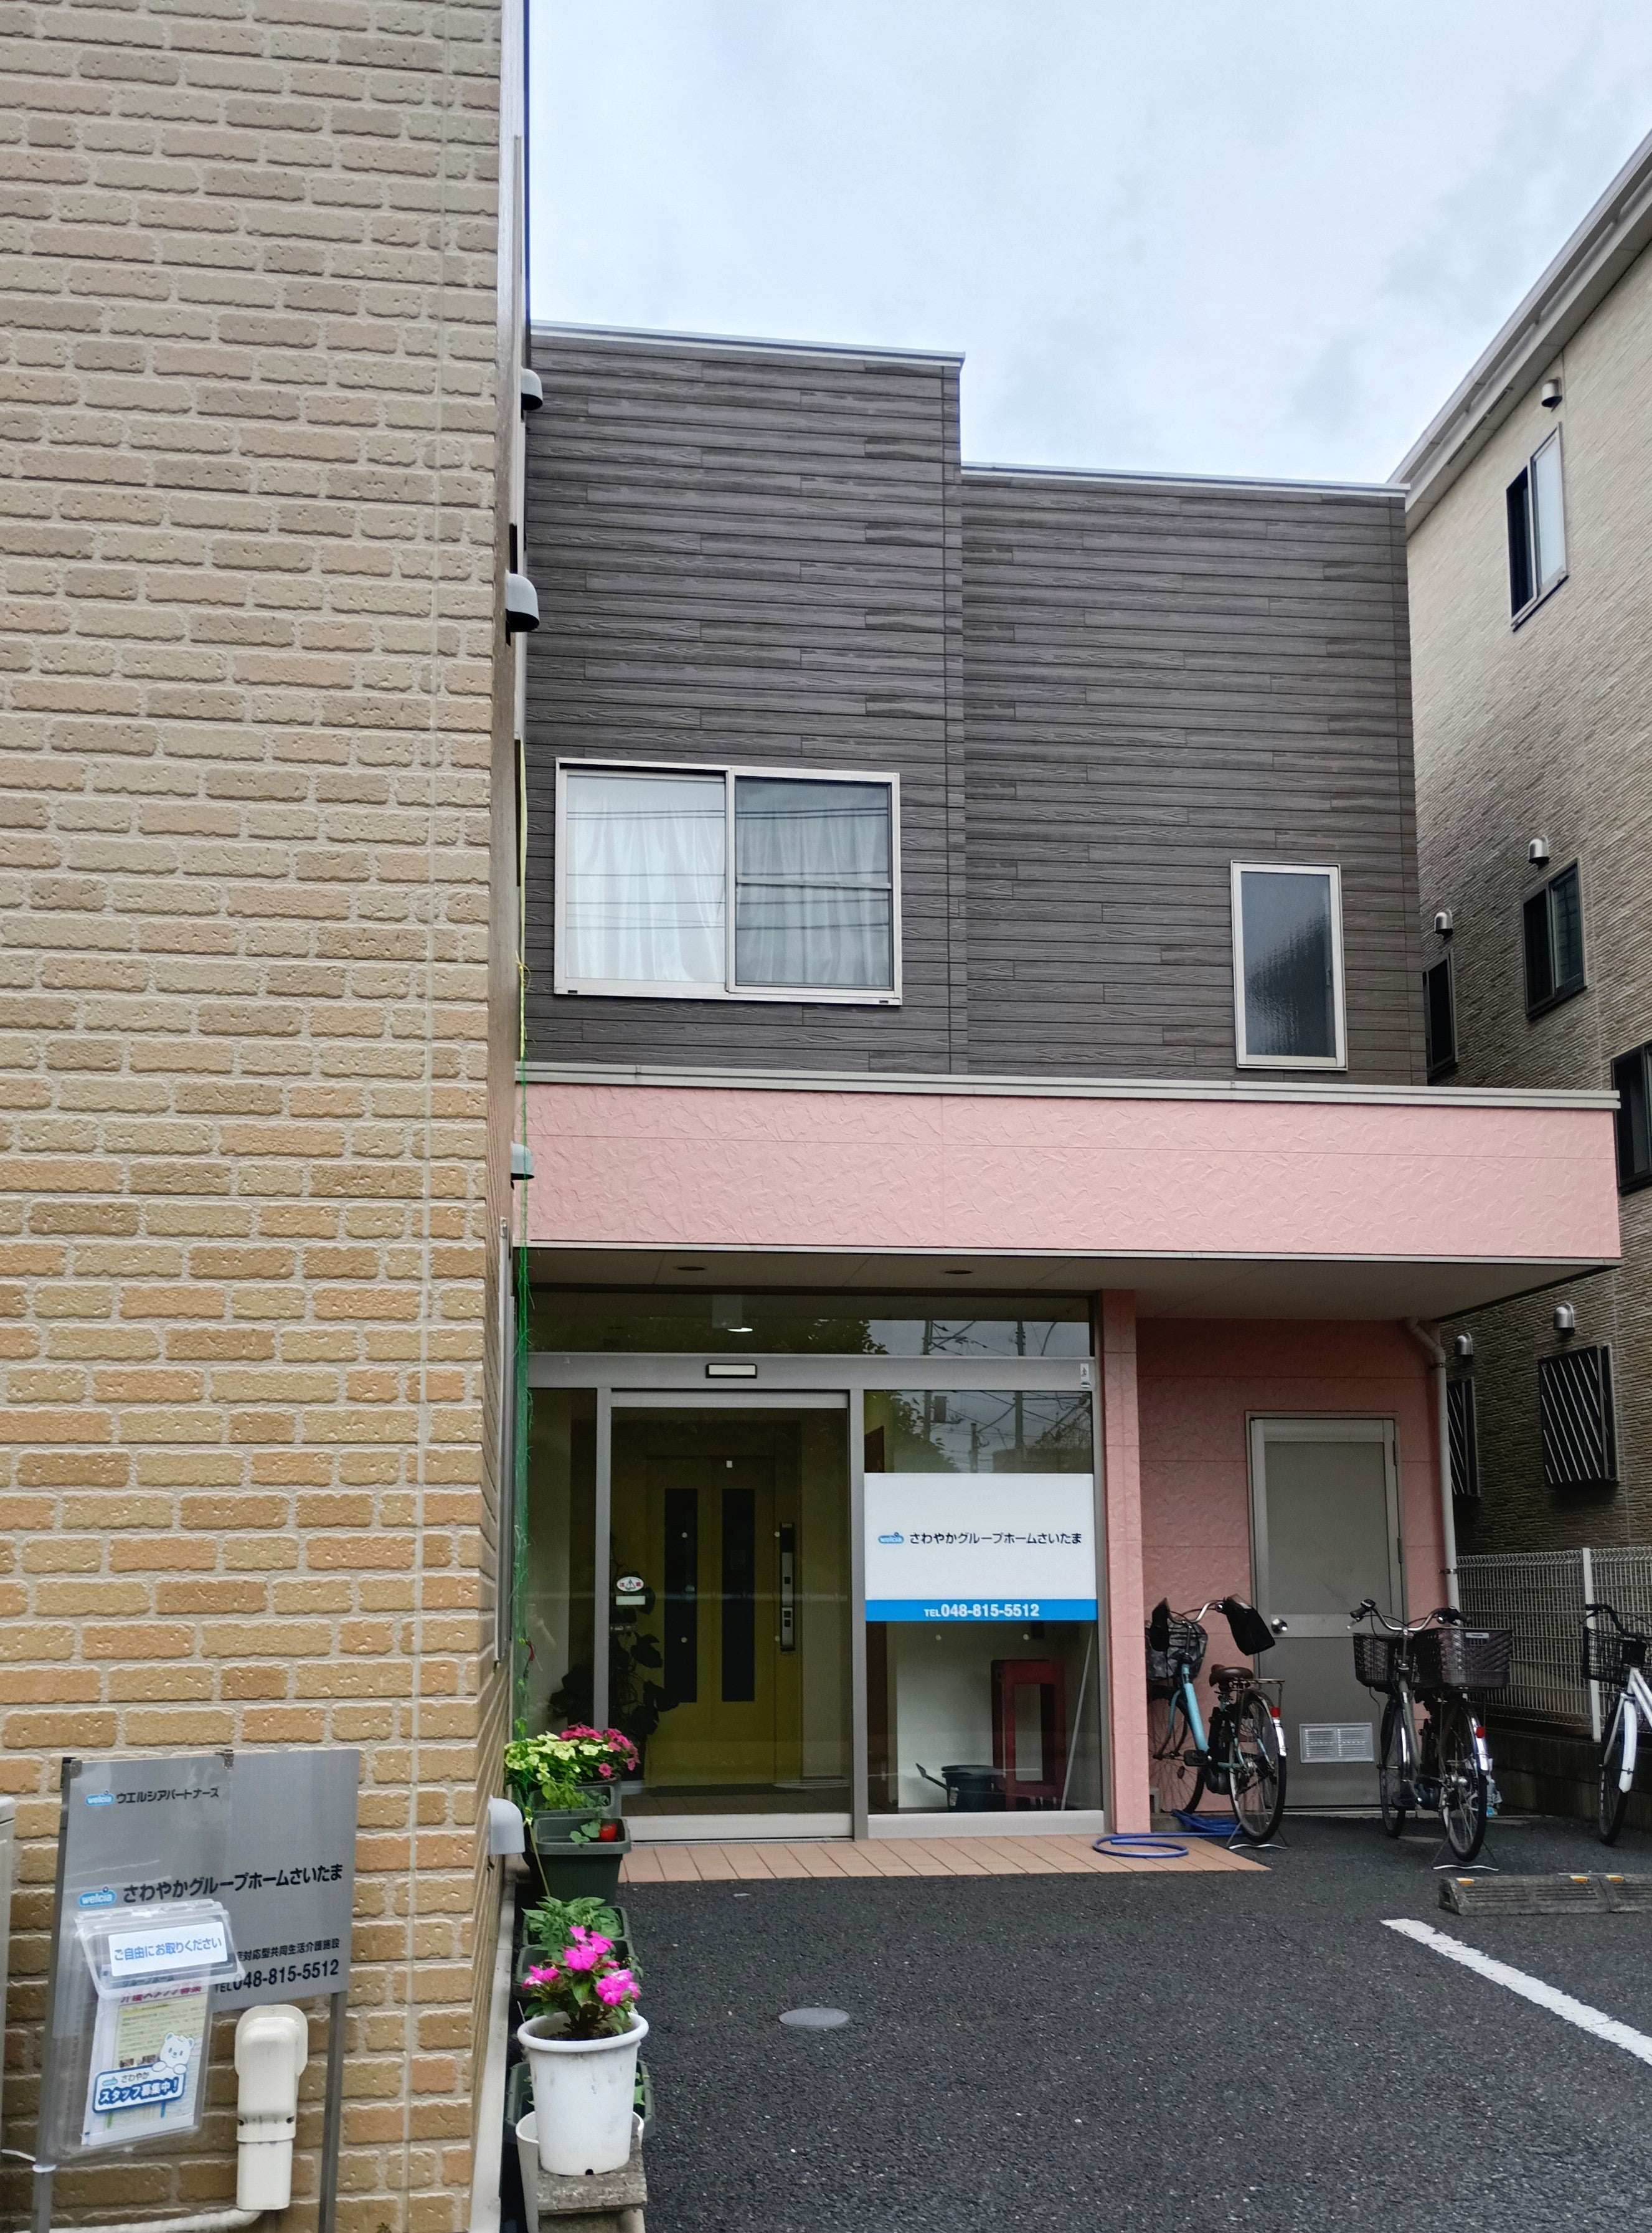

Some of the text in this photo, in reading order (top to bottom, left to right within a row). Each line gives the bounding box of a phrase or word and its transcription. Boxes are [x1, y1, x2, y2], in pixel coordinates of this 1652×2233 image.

[910, 1532, 1082, 1544] さわやかグループホームさいたま
[81, 1864, 343, 1905] welcia さわやかグループホームさいたま
[115, 1938, 222, 1961] ご自由にお取りください
